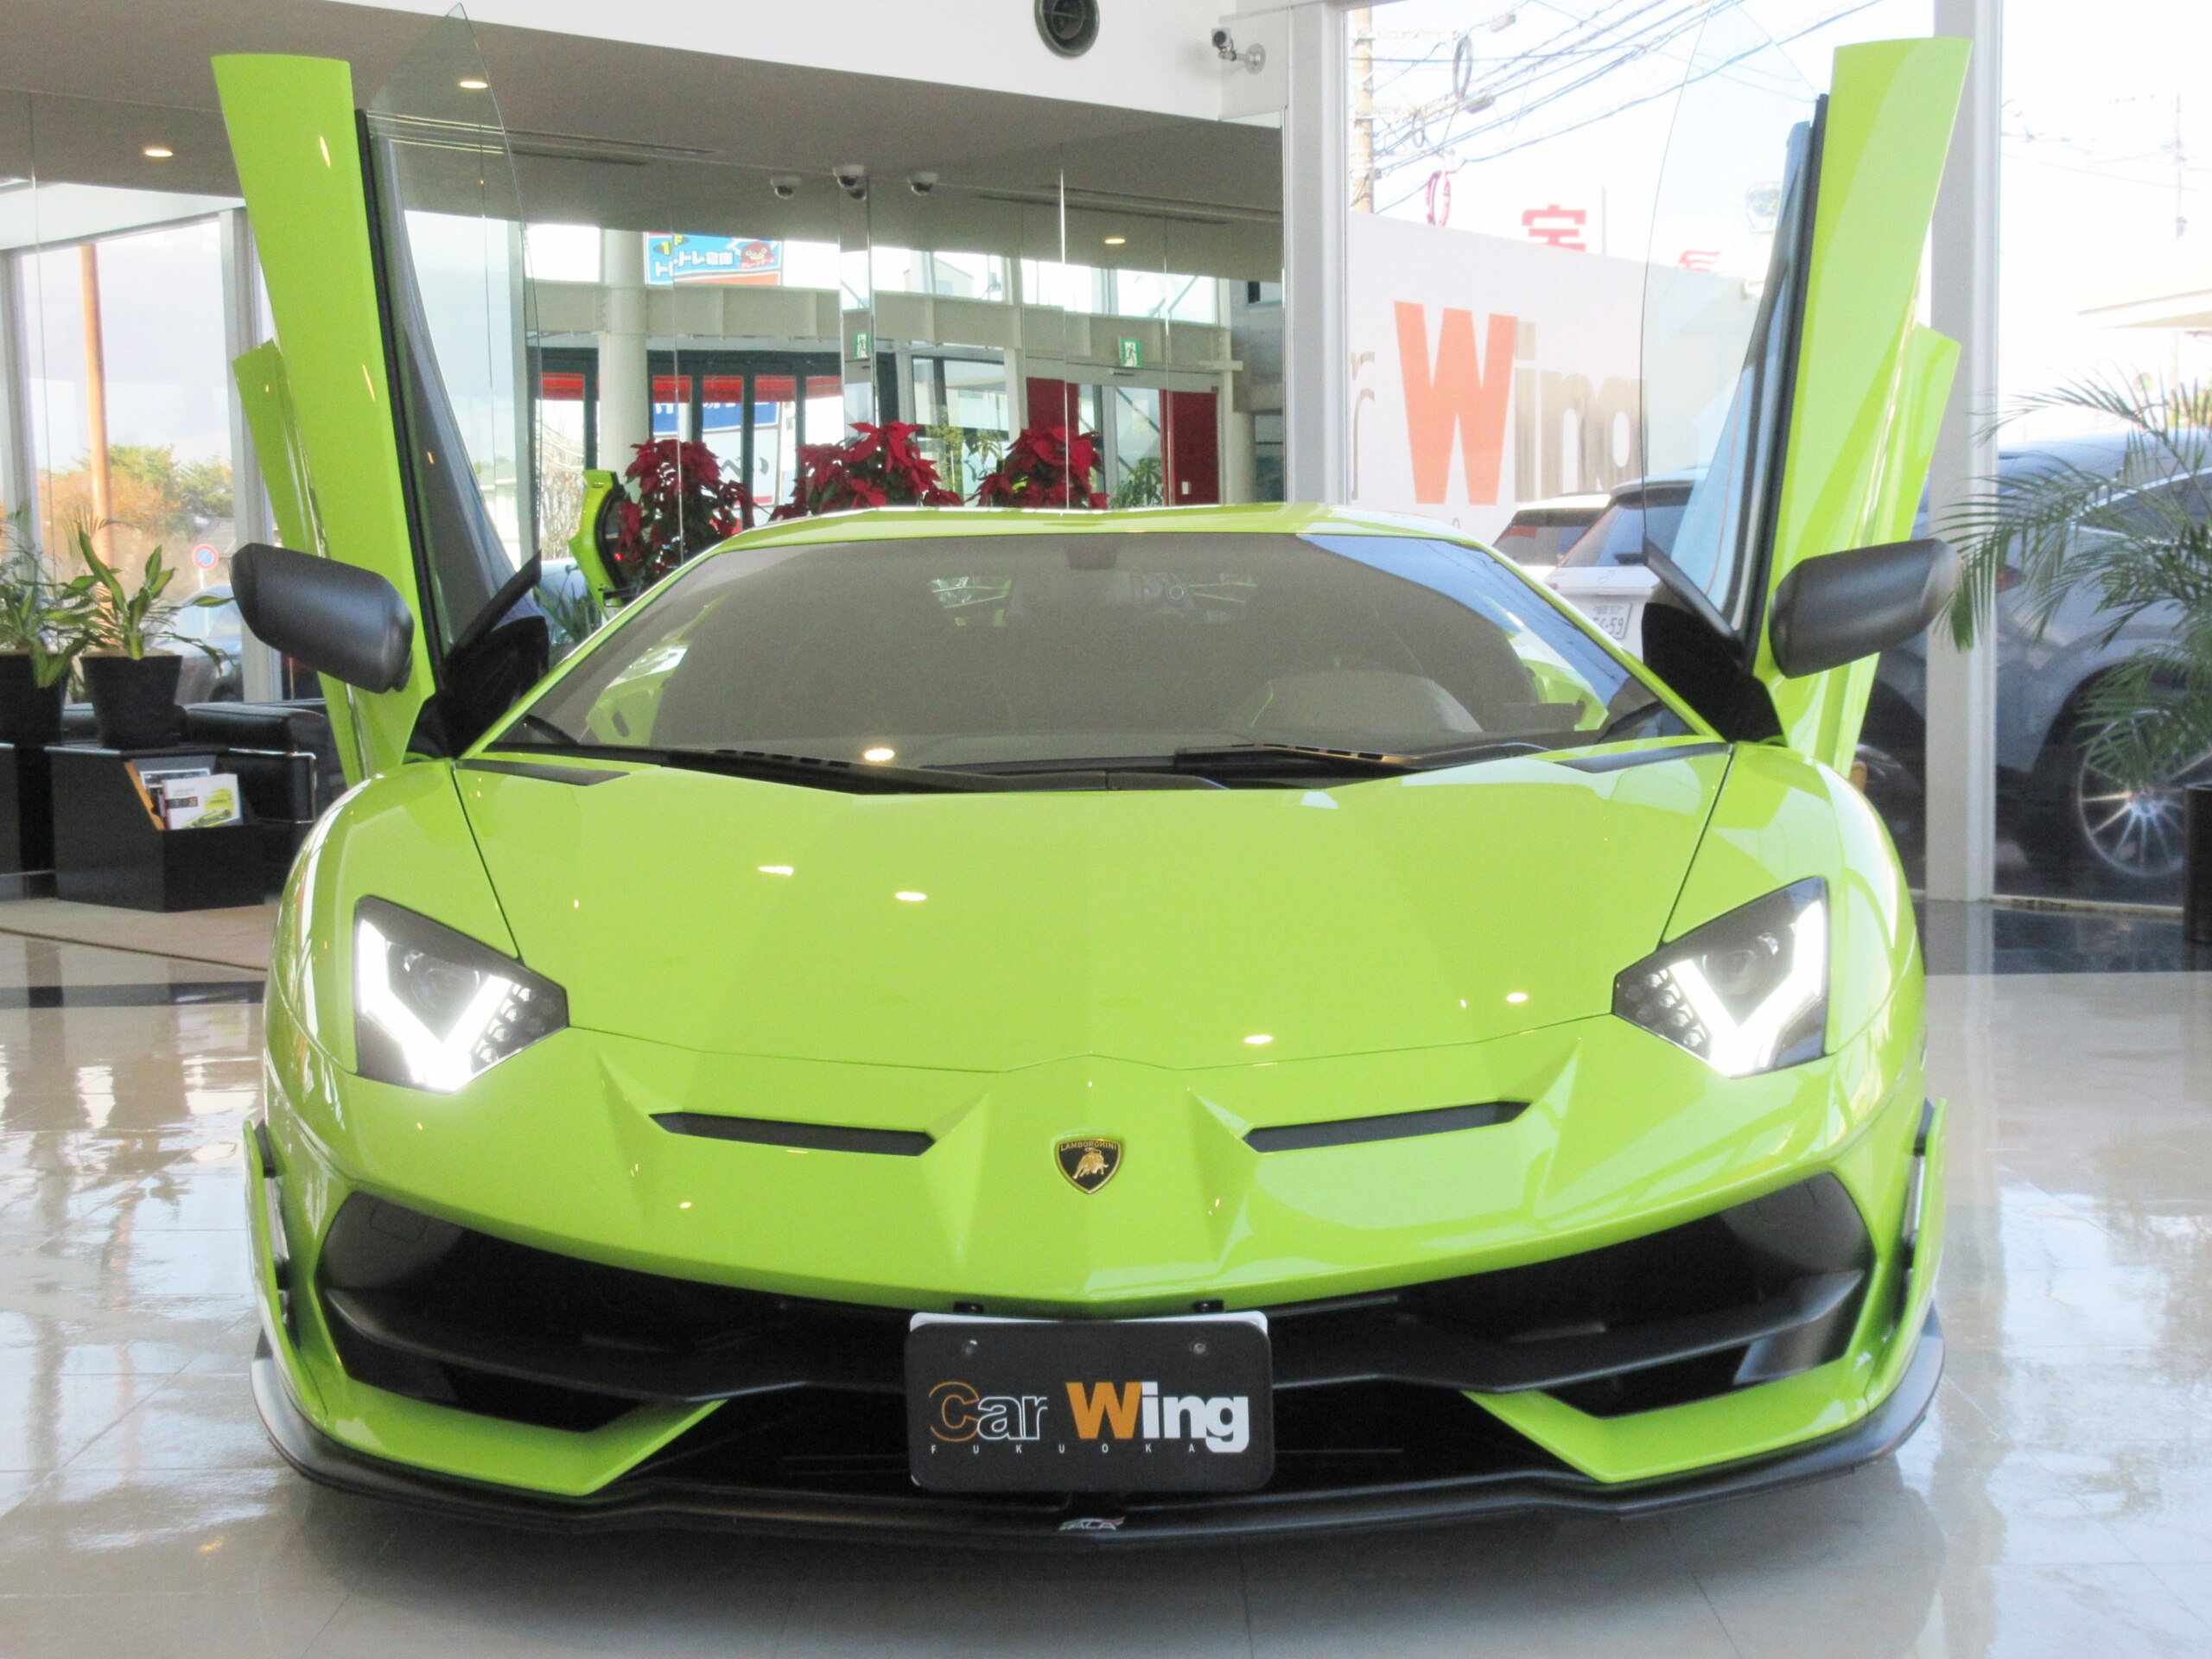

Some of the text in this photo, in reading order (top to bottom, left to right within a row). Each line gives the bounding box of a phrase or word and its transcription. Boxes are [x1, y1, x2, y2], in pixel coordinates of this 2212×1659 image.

[1060, 1140, 1117, 1152] LAMBORGHINI
[929, 1381, 1249, 1453] Car Wing
[931, 1444, 1196, 1454] FUKUOKA
